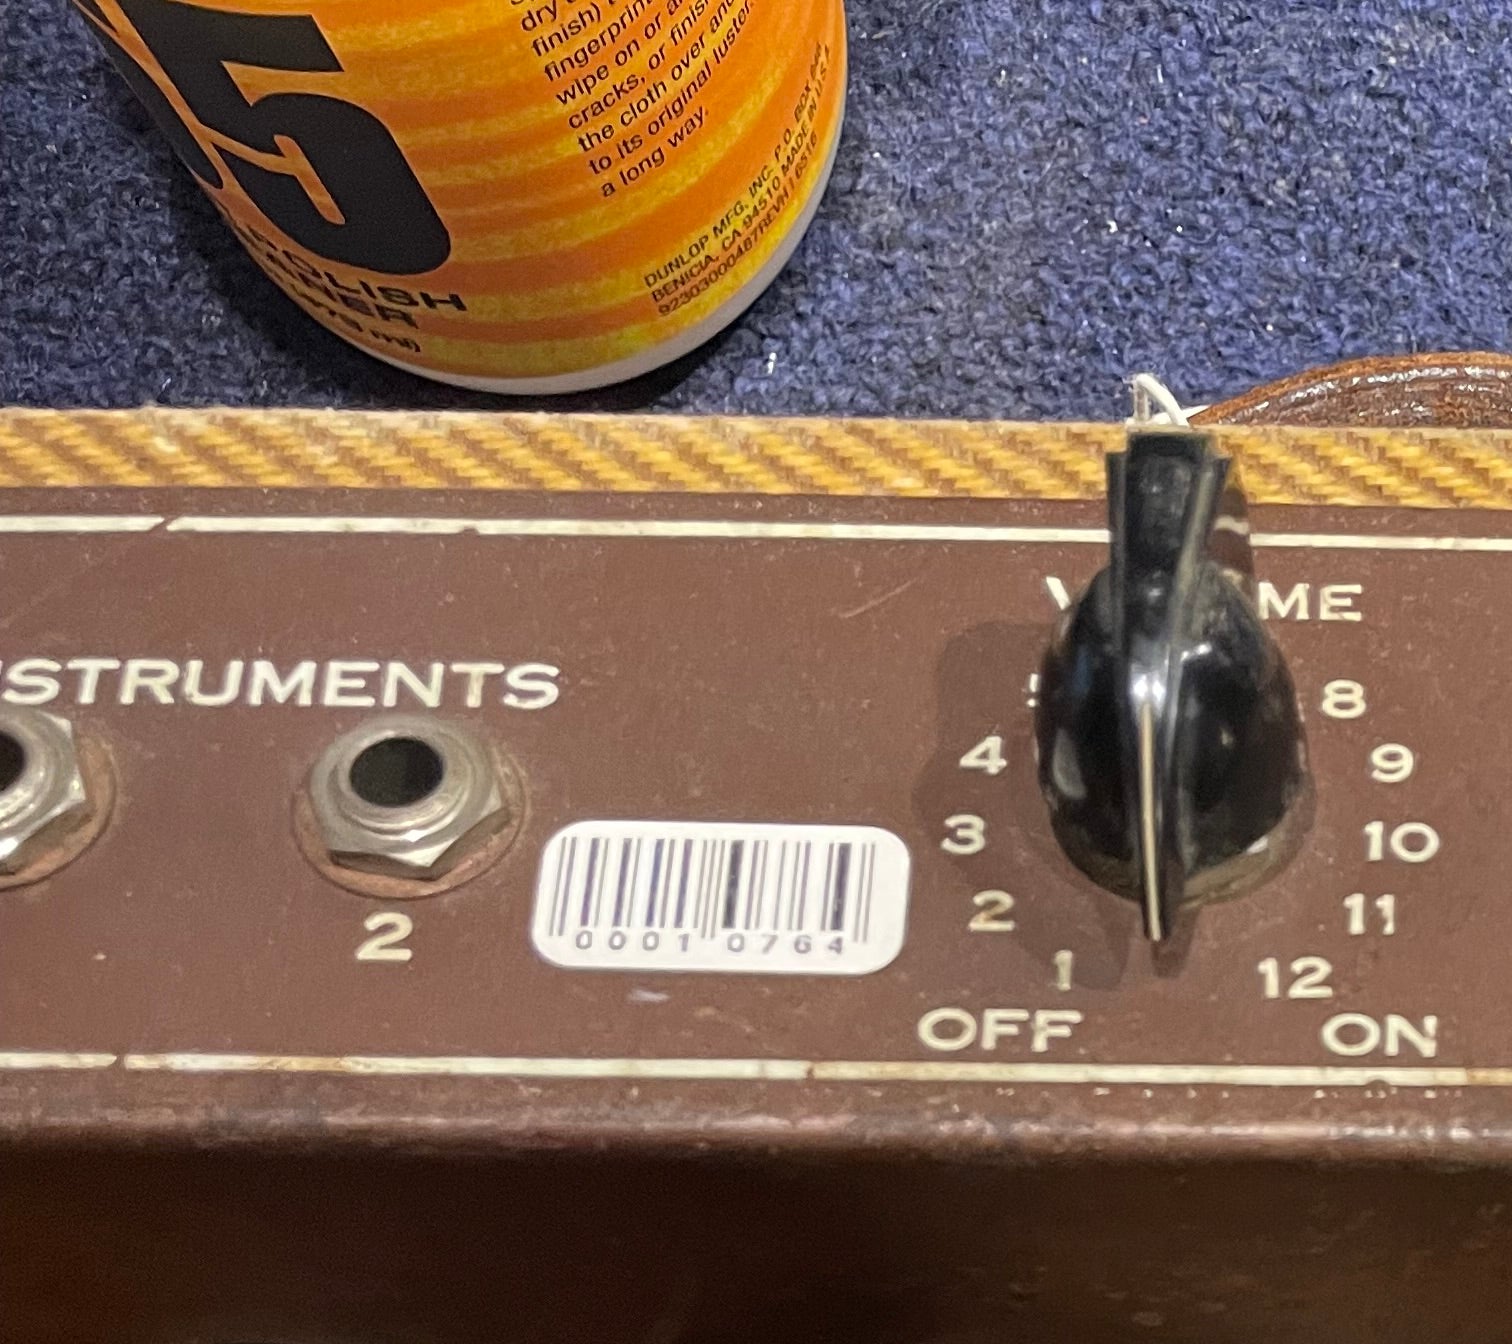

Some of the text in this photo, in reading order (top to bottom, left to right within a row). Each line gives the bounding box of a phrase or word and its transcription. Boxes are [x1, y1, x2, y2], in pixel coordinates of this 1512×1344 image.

[521, 0, 557, 31] dry
[531, 2, 601, 56] finish)
[556, 13, 662, 105] wipe on or
[568, 0, 710, 129] cracks, or finis
[578, 124, 614, 152] the
[620, 80, 667, 127] cloth
[671, 31, 707, 81] over
[589, 155, 612, 175] to
[617, 134, 643, 159] its
[648, 59, 712, 135] original
[602, 106, 709, 198] a long way.
[644, 235, 710, 289] DUNLOP
[721, 229, 743, 252] CA
[0, 658, 561, 710] STRUMENTS
[1321, 679, 1367, 719] 8
[958, 735, 1007, 774] 4
[1369, 741, 1415, 783] 9
[940, 814, 986, 855] 3
[1363, 820, 1440, 863] 10
[968, 889, 1016, 932] 2
[1343, 892, 1398, 936] 11
[354, 913, 414, 962] 2
[1052, 949, 1074, 992] 1
[1257, 955, 1334, 1000] 12
[917, 1007, 1084, 1053] OFF
[1320, 1013, 1439, 1059] ON
